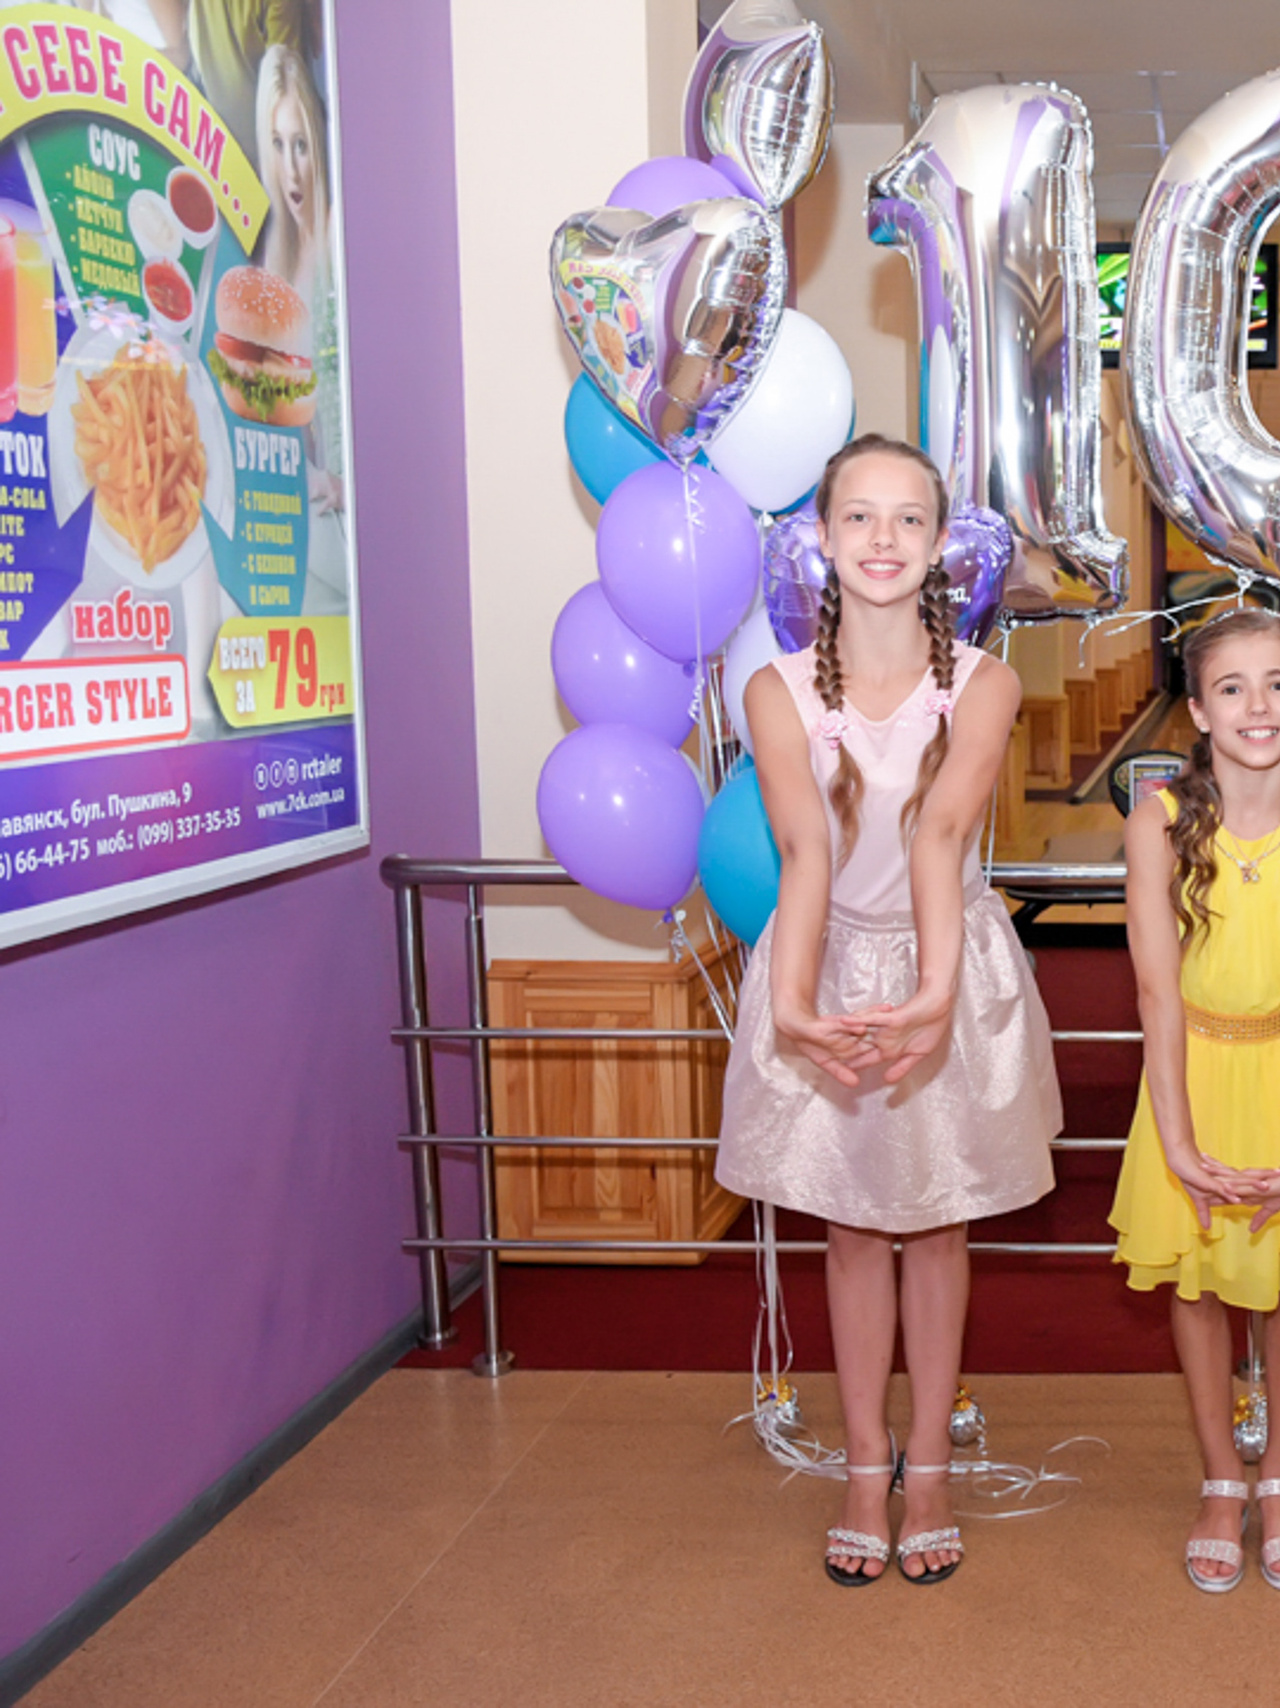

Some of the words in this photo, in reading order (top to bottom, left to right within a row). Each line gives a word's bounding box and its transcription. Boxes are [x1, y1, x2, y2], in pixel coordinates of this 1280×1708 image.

[3, 25, 128, 104] СЕБЕ
[88, 123, 141, 181] СОУС
[234, 426, 300, 477] БУРГЕР
[74, 590, 171, 646] набор
[220, 636, 266, 670] ВСЕГО
[267, 627, 318, 710] 79
[0, 683, 75, 733] RGER
[86, 676, 173, 725] STYLE
[236, 680, 256, 713] ЗА
[1, 809, 69, 838] авянск,
[71, 798, 105, 828] бул.
[182, 782, 192, 804] 9
[15, 837, 91, 875] 66-44-75
[137, 818, 174, 850] (099)
[176, 806, 241, 839] 337-35-35
